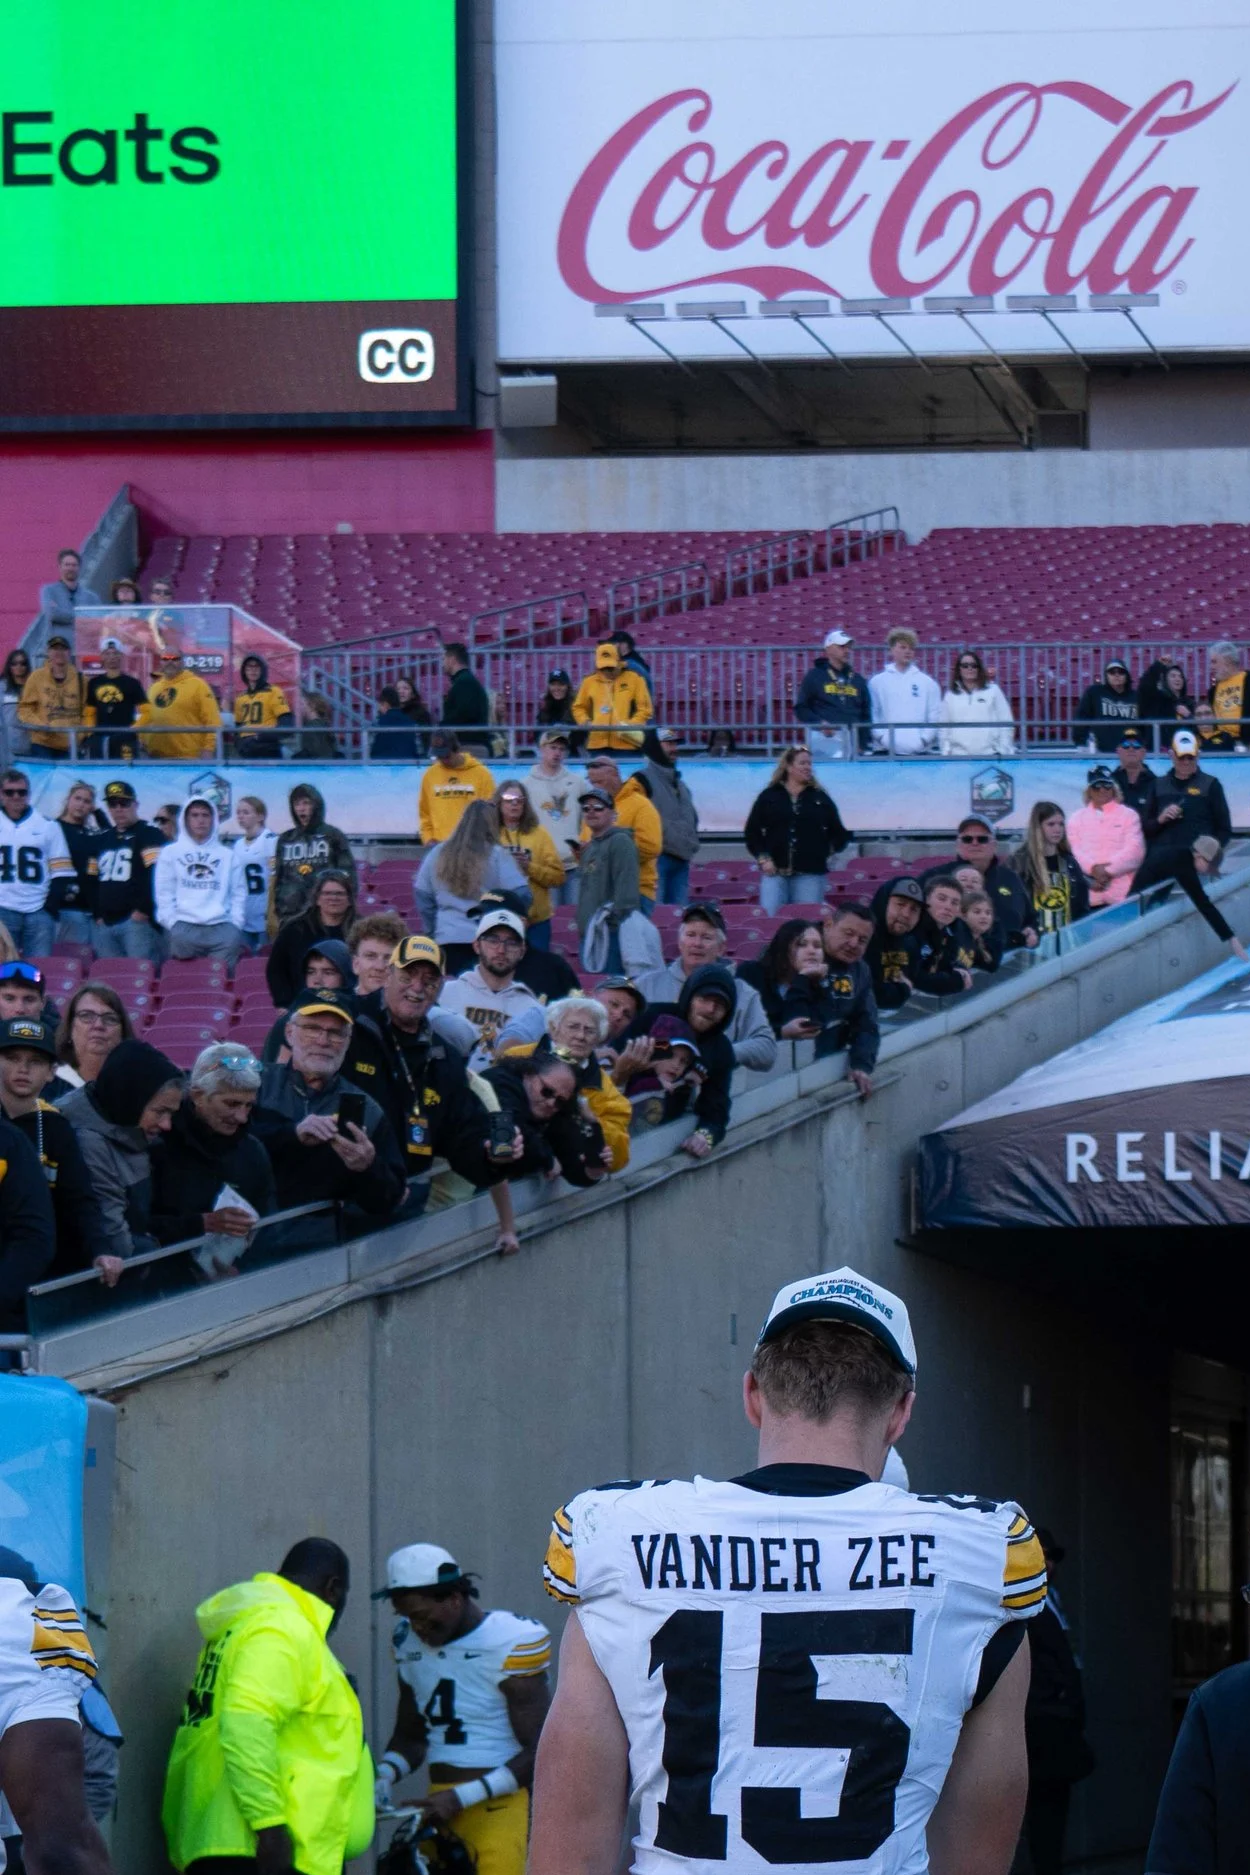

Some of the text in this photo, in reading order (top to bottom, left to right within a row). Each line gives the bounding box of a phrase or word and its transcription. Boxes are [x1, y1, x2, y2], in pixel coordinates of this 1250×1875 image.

[2, 111, 222, 187] Eats
[558, 79, 1239, 303] Coca-Cola
[367, 338, 426, 378] CC
[99, 848, 132, 882] 46
[176, 851, 222, 868] IOWA
[283, 841, 329, 861] IOWA
[790, 1284, 893, 1320] CHAMPIONS
[829, 1278, 861, 1286] RELIAQUEST
[860, 1285, 874, 1295] BOWL
[631, 1534, 936, 1594] VANDER ZEE
[424, 1677, 468, 1745] 4
[648, 1608, 915, 1866] 15
